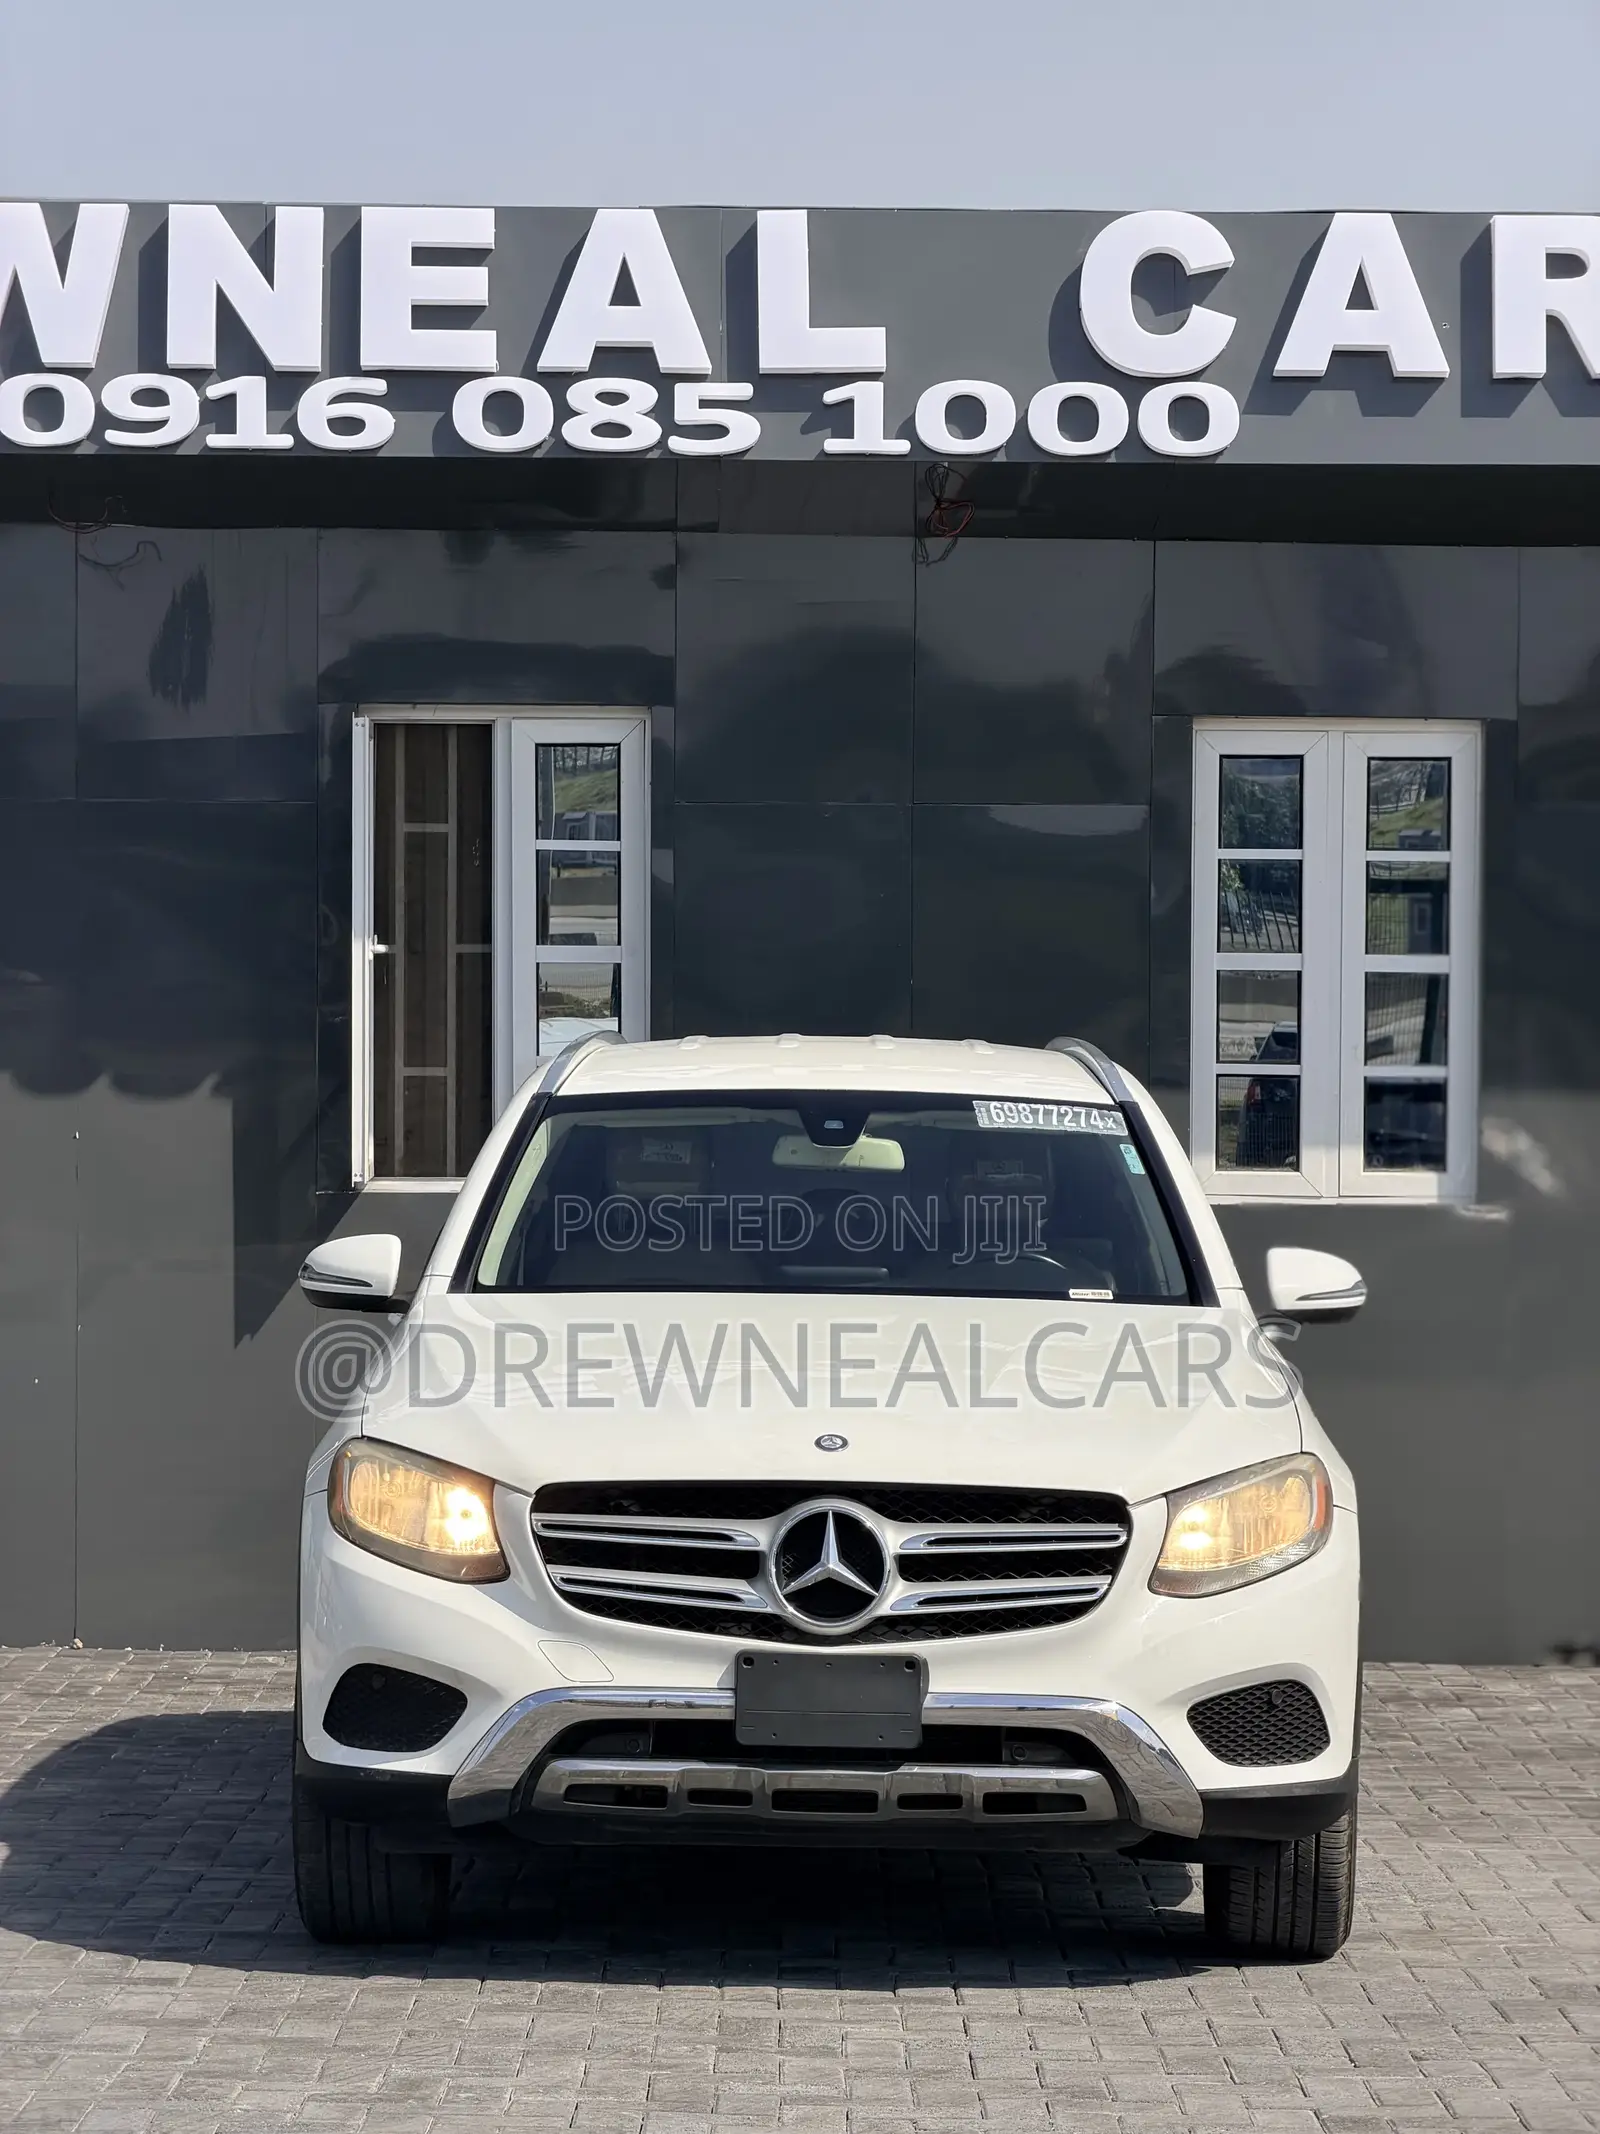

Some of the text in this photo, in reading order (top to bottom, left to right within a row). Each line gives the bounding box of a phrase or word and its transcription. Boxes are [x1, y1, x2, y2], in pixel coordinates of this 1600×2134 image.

[1080, 210, 1600, 379] CAR
[0, 373, 1241, 457] 0916 085 1000
